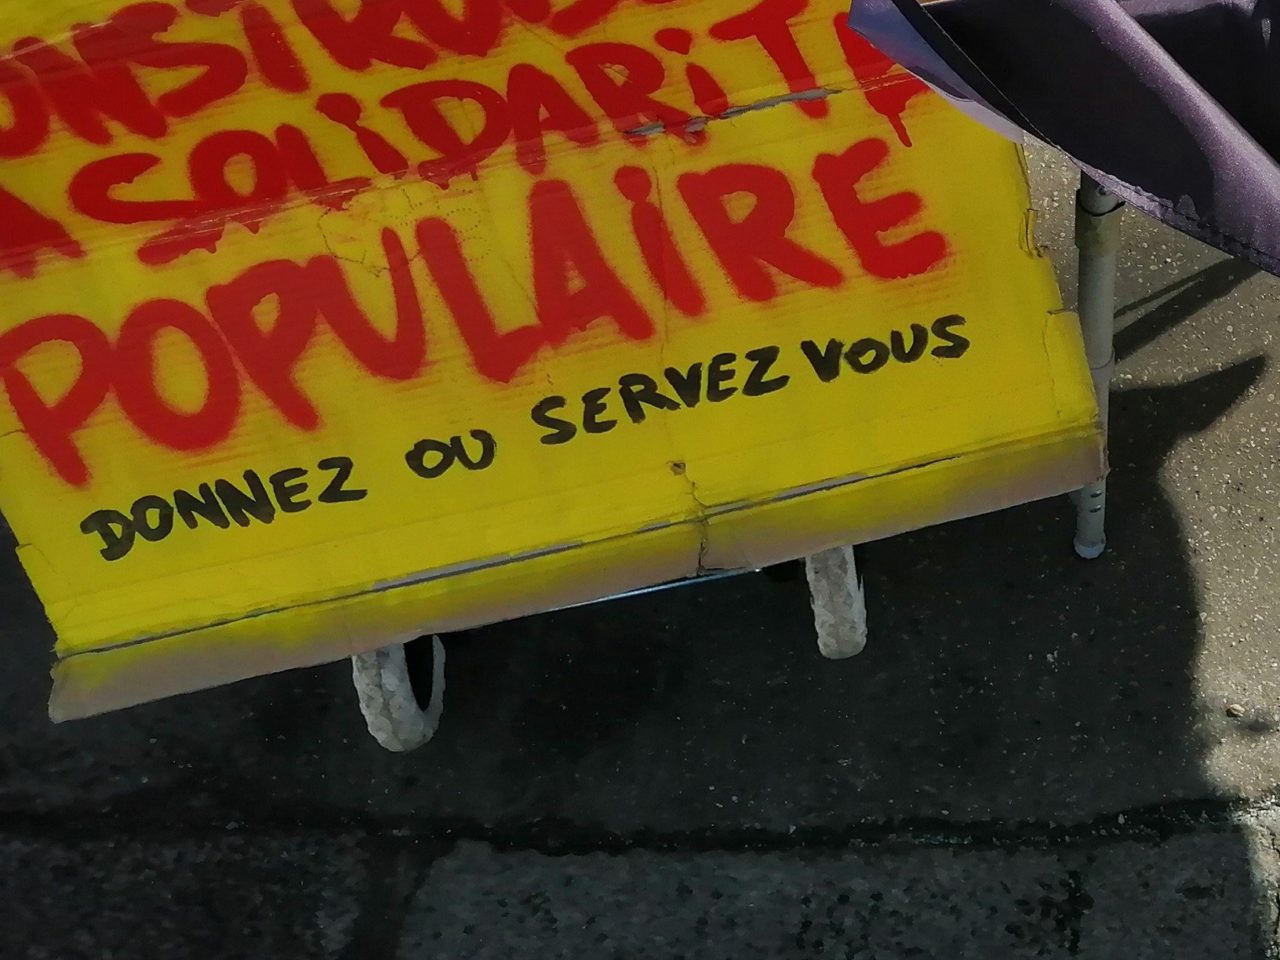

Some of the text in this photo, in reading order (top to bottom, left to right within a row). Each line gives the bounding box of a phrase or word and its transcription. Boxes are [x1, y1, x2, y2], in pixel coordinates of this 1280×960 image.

[79, 313, 971, 562] DONNEZ OU SERVEZ VOUS
